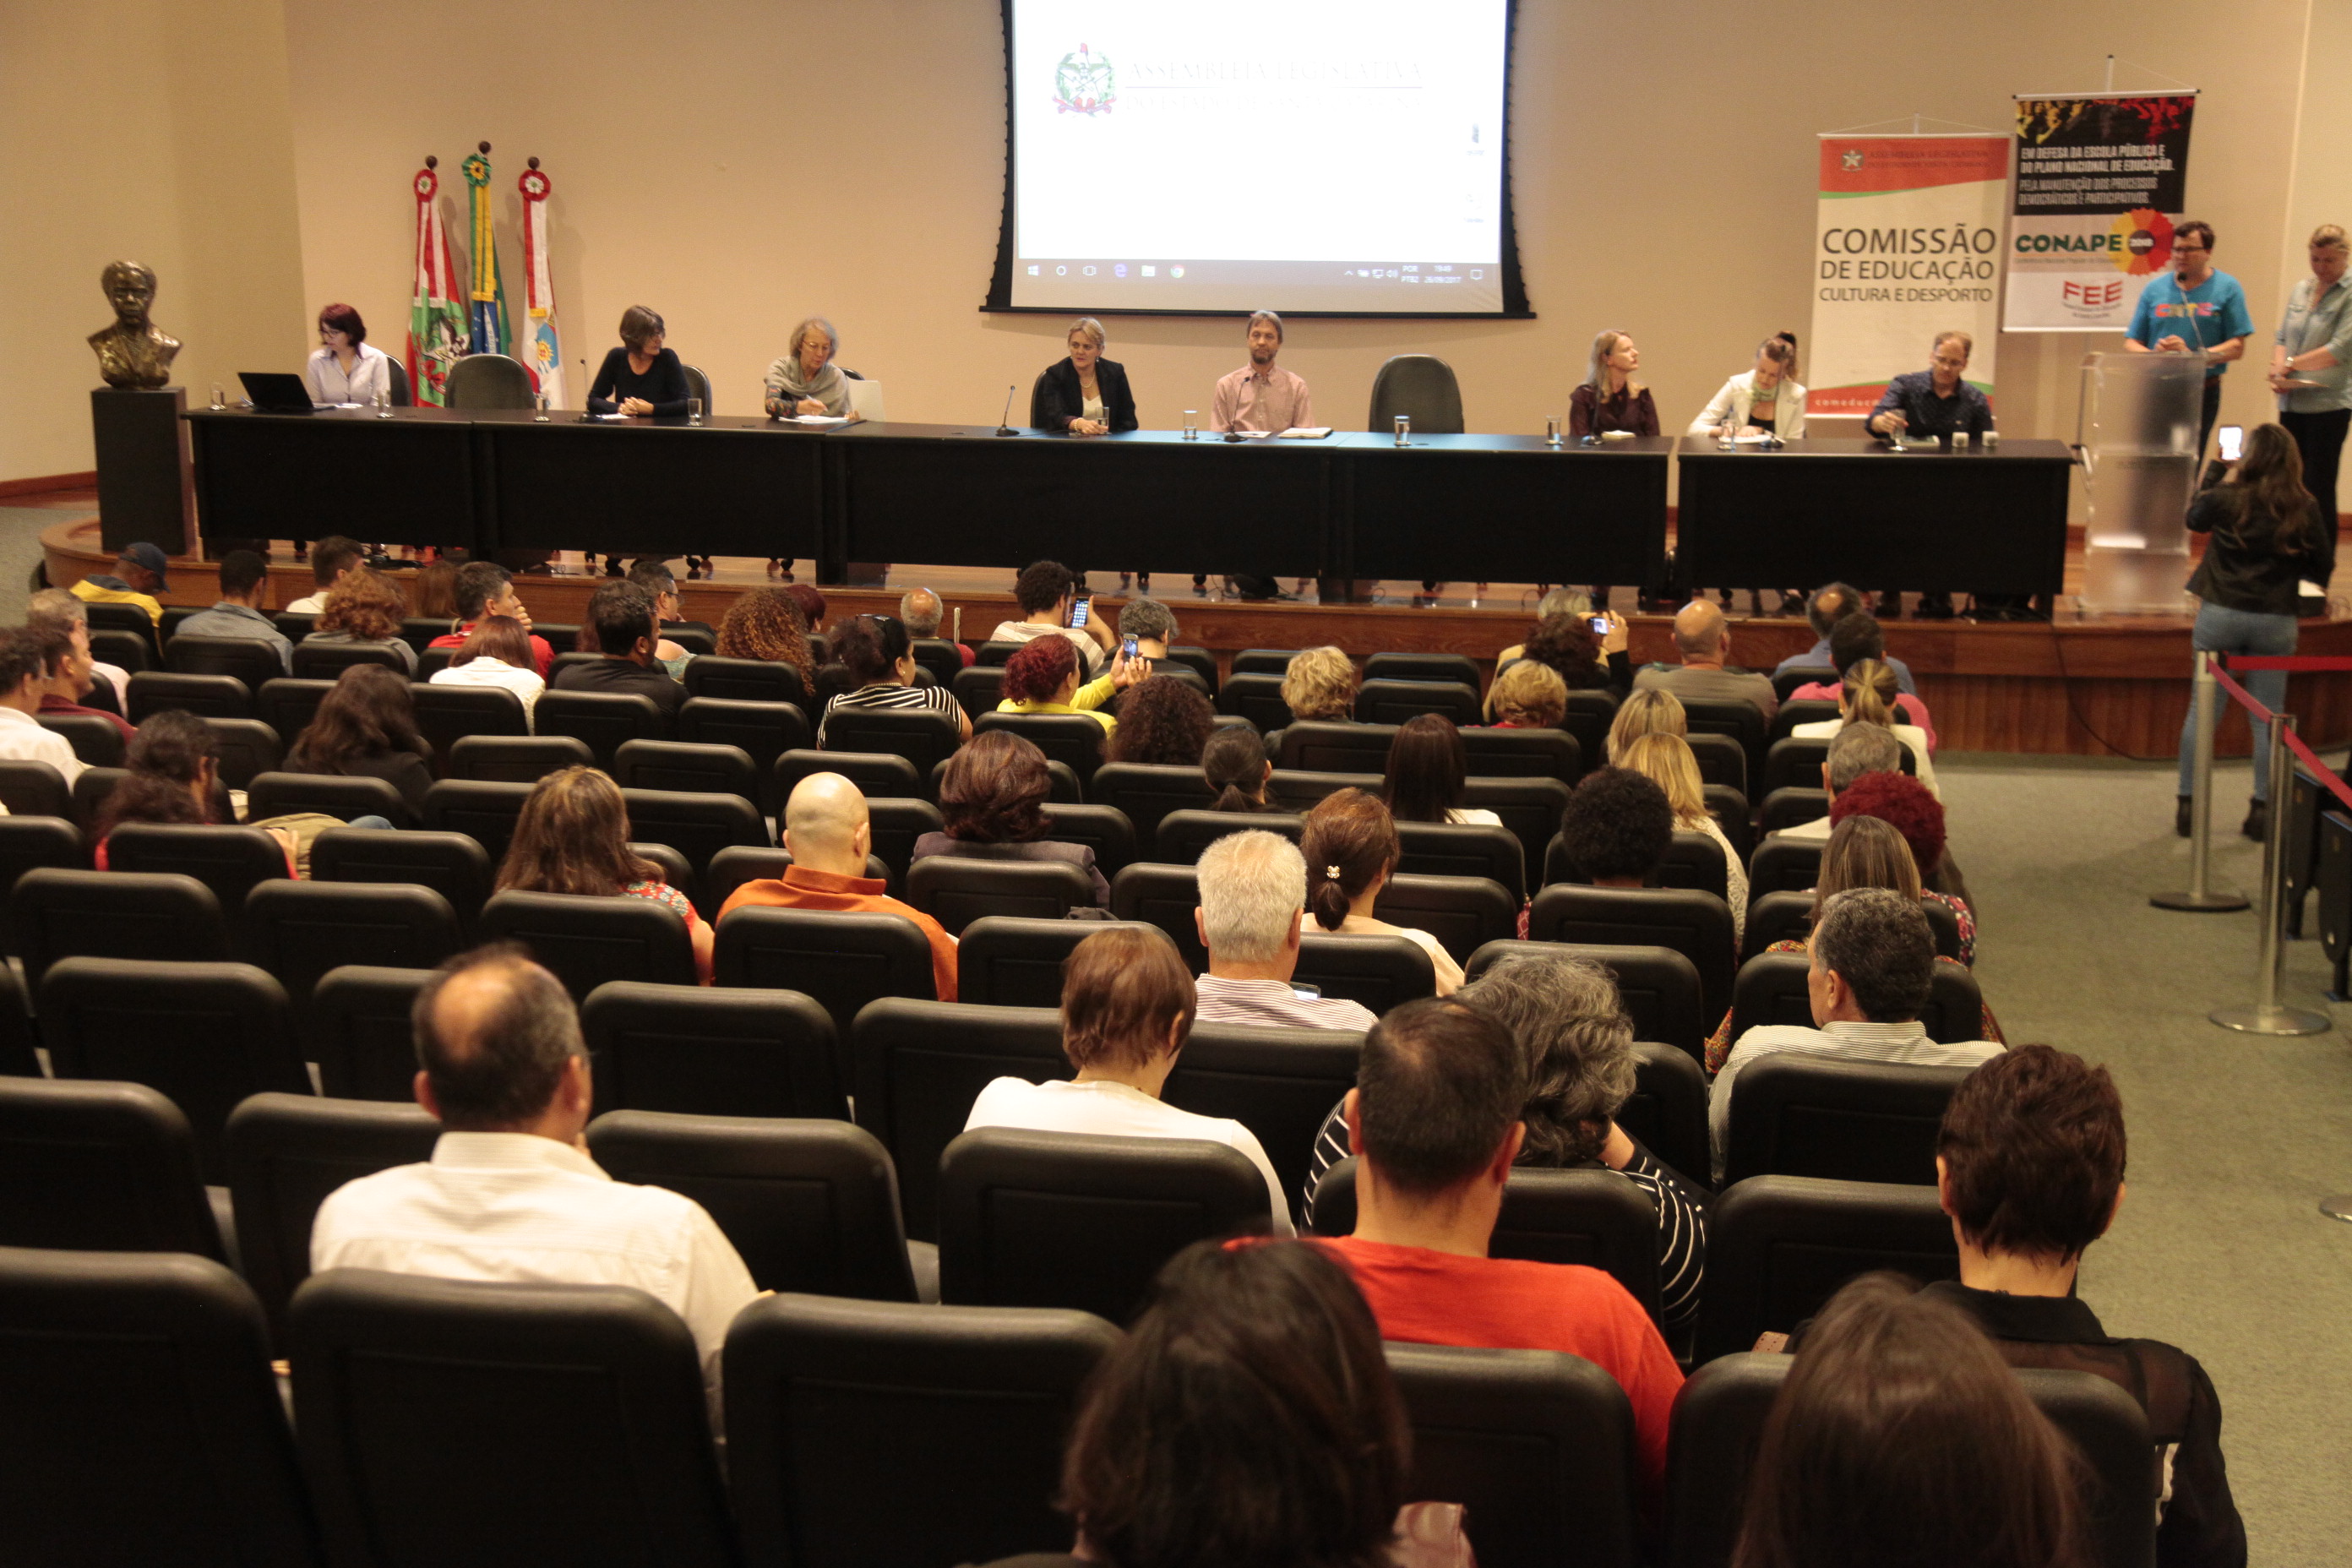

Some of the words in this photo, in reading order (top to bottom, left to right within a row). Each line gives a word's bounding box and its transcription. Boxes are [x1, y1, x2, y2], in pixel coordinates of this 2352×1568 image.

[1128, 61, 1267, 80] ASSEMBLEIA
[1277, 61, 1423, 80] LEGISLATIVA
[1125, 95, 1154, 112] DO
[1162, 95, 1230, 112] ESTADO
[2021, 147, 2035, 160] EM
[2036, 146, 2069, 159] DEFESA
[2070, 146, 2082, 159] DA
[2083, 145, 2117, 159] ESCOLA
[2118, 143, 2158, 158] PÚBLICA
[2159, 144, 2165, 157] E
[2020, 161, 2034, 173] DO
[2034, 161, 2063, 173] PLANO
[2064, 160, 2110, 172] NACIONAL
[2110, 160, 2123, 172] DE
[2111, 177, 2159, 189] PROCESSOS
[1822, 222, 1997, 255] COMISSÃO
[2015, 234, 2123, 253] CONAPE
[1821, 260, 1851, 280] DE
[1859, 257, 1995, 286] EDUCAÇÃO
[1819, 288, 1892, 302] CULTURA
[1895, 288, 1905, 302] E
[1908, 288, 1994, 302] DESPORTO
[2062, 280, 2124, 305] FEE
